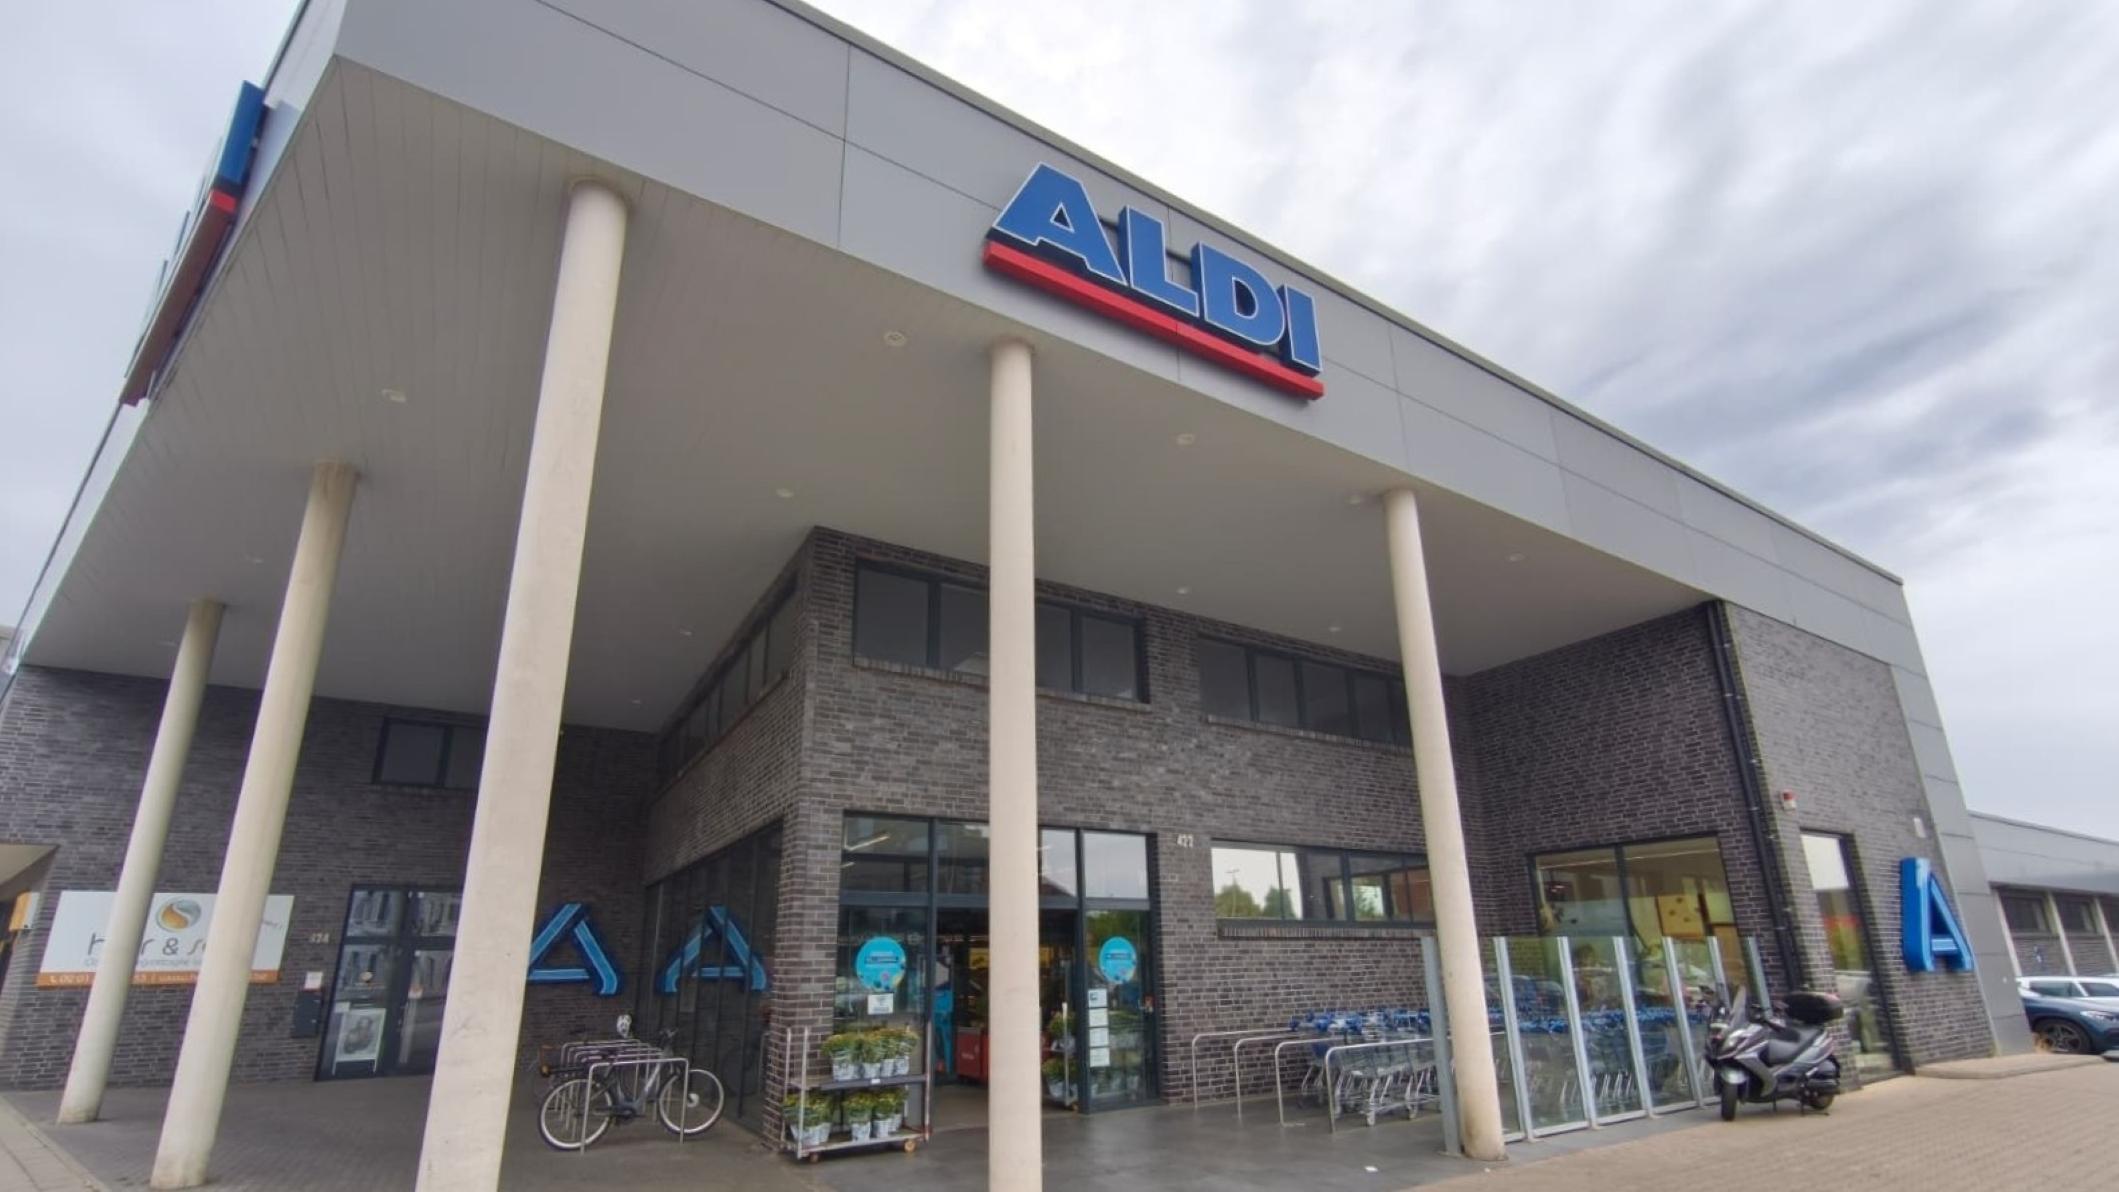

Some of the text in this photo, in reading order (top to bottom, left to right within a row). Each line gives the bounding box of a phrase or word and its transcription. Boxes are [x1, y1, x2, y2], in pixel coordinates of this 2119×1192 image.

[987, 161, 1322, 376] ALDI
[1176, 833, 1194, 848] 422
[162, 937, 180, 956] &
